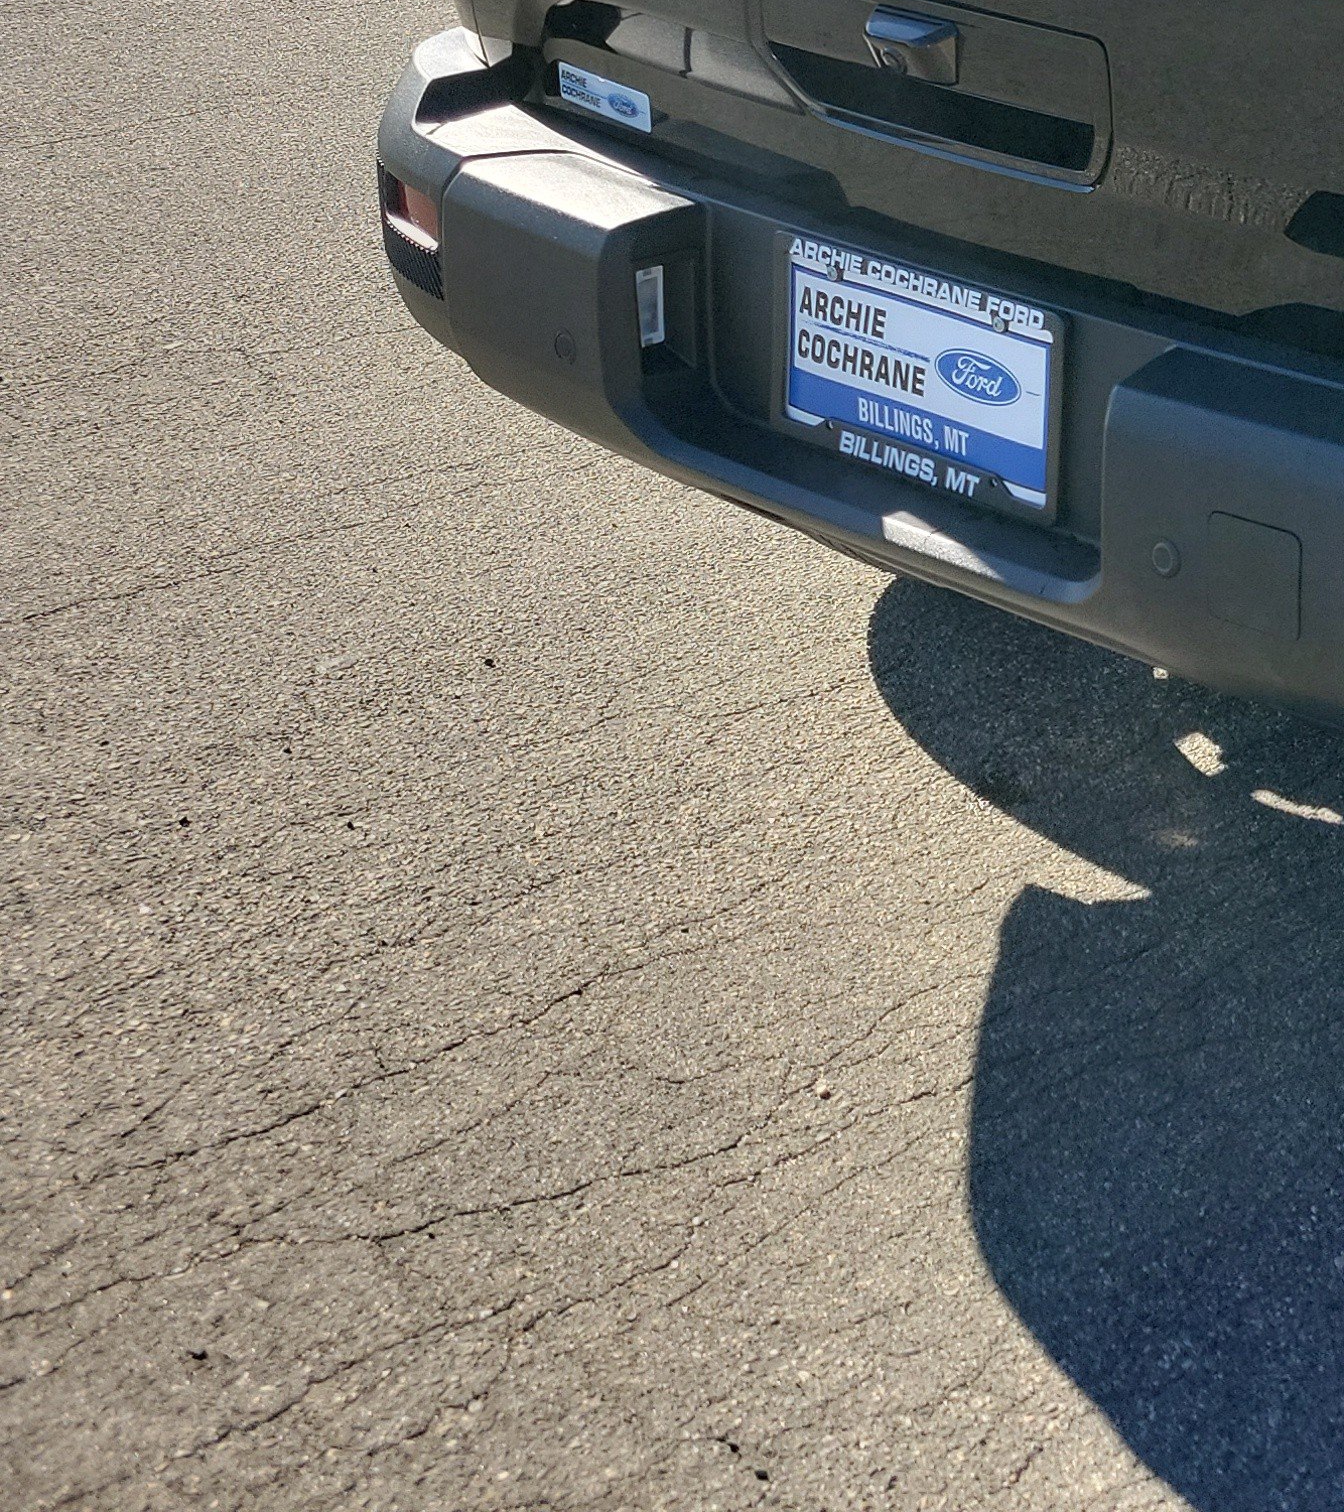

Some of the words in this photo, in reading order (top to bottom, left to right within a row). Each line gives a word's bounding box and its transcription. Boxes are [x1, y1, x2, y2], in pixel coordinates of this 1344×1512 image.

[561, 69, 588, 88] ARCHIE
[561, 84, 601, 108] COCHRANE
[789, 238, 863, 274] ARCHIE
[867, 260, 979, 309] COCHRANE
[985, 299, 1045, 330] FORD
[800, 286, 887, 339] ARCHIE
[797, 329, 926, 397] COCHRANE
[952, 354, 1003, 398] Ford
[858, 397, 940, 449] BILLINGS,
[944, 426, 970, 456] MT
[839, 431, 939, 488] BILLINGS,
[945, 467, 980, 498] MT
